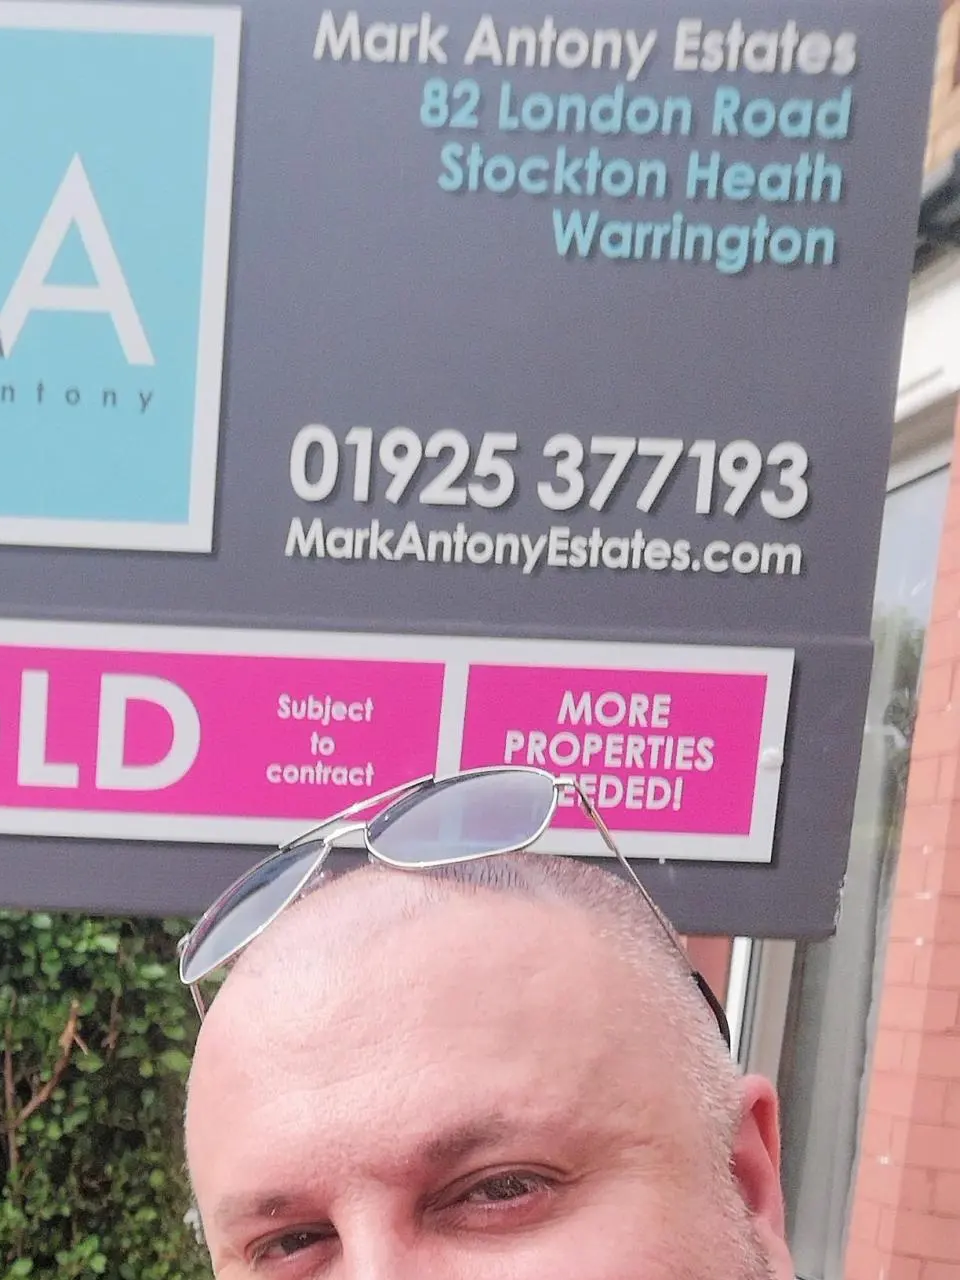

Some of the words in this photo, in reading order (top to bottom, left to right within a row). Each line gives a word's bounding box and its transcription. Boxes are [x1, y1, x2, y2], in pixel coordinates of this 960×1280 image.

[313, 10, 448, 64] Mark
[464, 14, 657, 81] Antony
[674, 18, 857, 75] Estates
[419, 77, 481, 130] 82
[498, 81, 692, 136] London
[712, 85, 852, 139] Road
[438, 142, 666, 198] Stockton
[686, 151, 841, 203] Heath
[552, 209, 836, 273] Warrington
[289, 424, 518, 508] 01925
[537, 433, 809, 519] 377193
[285, 517, 803, 576] MarkAntonyEstates.com
[277, 693, 374, 726] Subject
[557, 690, 671, 728] MORE
[310, 732, 335, 757] to
[504, 730, 715, 771] PROPERTIES
[266, 762, 374, 787] contract
[554, 773, 684, 812] EEDED!
